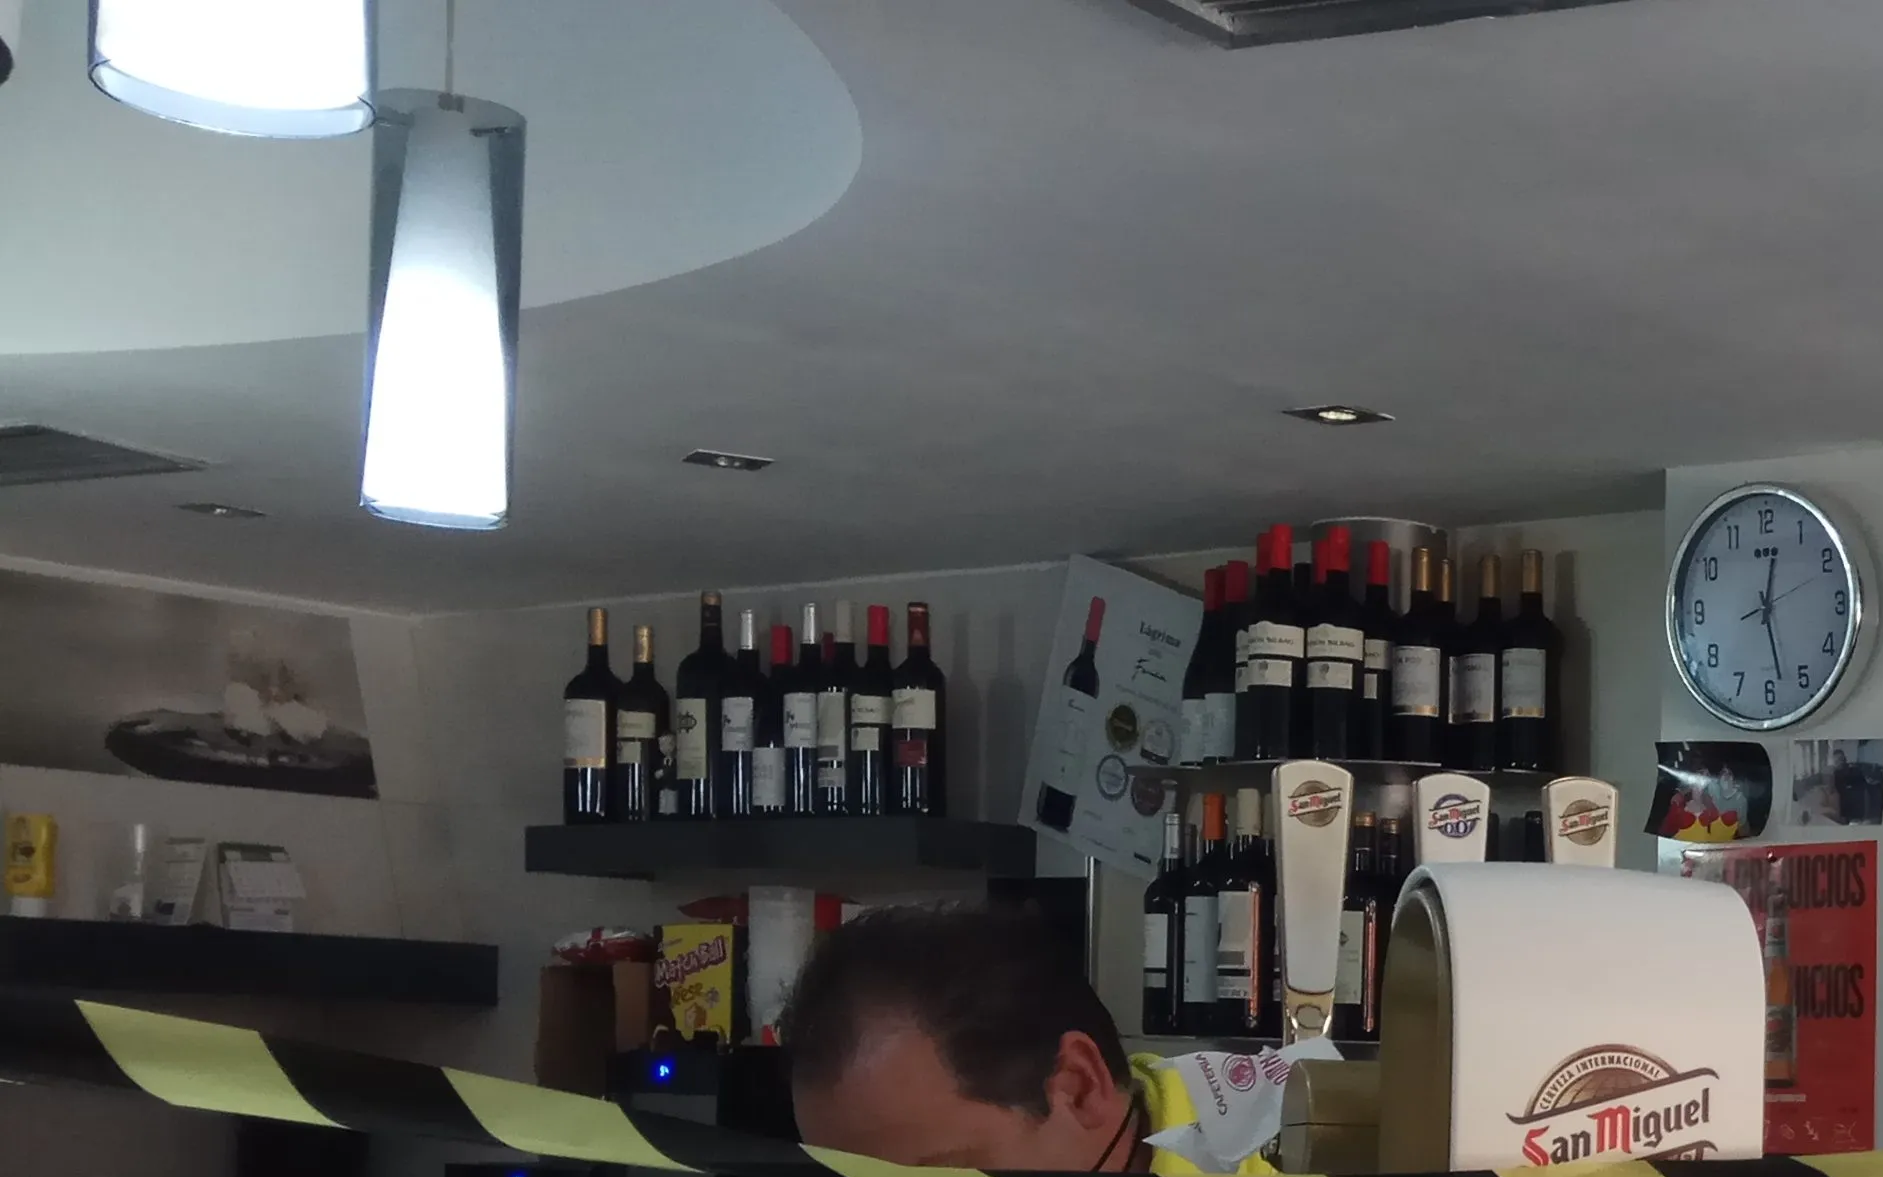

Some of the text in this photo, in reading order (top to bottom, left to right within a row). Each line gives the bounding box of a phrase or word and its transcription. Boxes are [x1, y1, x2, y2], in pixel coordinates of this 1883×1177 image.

[1757, 509, 1774, 534] 12
[1797, 521, 1803, 544] 1
[1726, 525, 1740, 549] 11
[1703, 557, 1718, 581] 10
[1822, 548, 1833, 573] 2
[1694, 600, 1705, 625] 9
[1834, 590, 1846, 615] 3
[1707, 644, 1719, 668] 8
[1822, 632, 1834, 656] 4
[1733, 671, 1745, 696] 7
[1798, 665, 1810, 689] 5
[1764, 680, 1775, 705] 6
[1539, 1055, 1660, 1110] CERVEZA INTERNACIONAL
[1522, 1087, 1710, 1167] San Miguel
